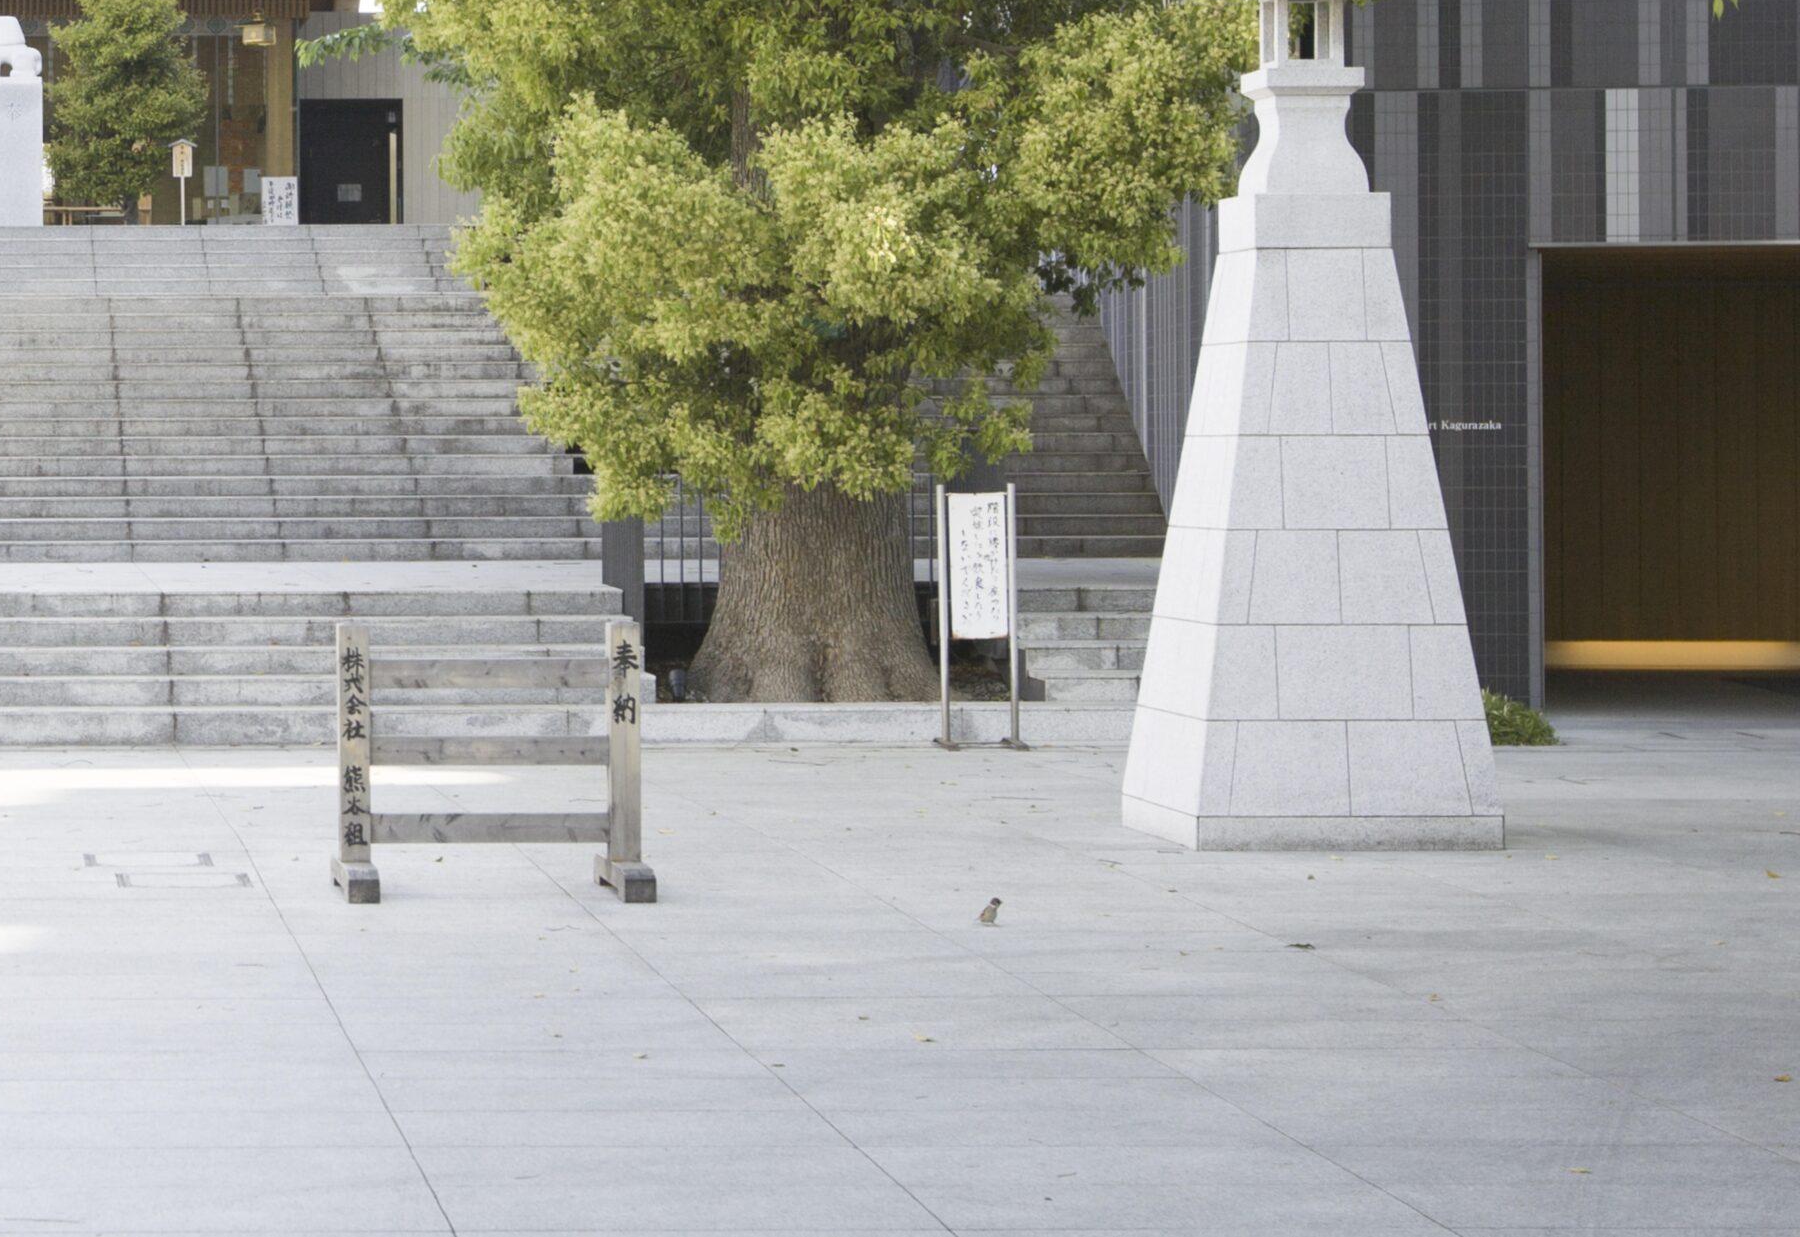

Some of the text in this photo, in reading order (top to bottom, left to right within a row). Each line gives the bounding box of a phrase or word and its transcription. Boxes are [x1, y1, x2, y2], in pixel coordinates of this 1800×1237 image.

[1442, 420, 1502, 431] Kagurazaka
[611, 639, 640, 725] 奉納
[341, 646, 370, 847] 株式会社 熊谷組
